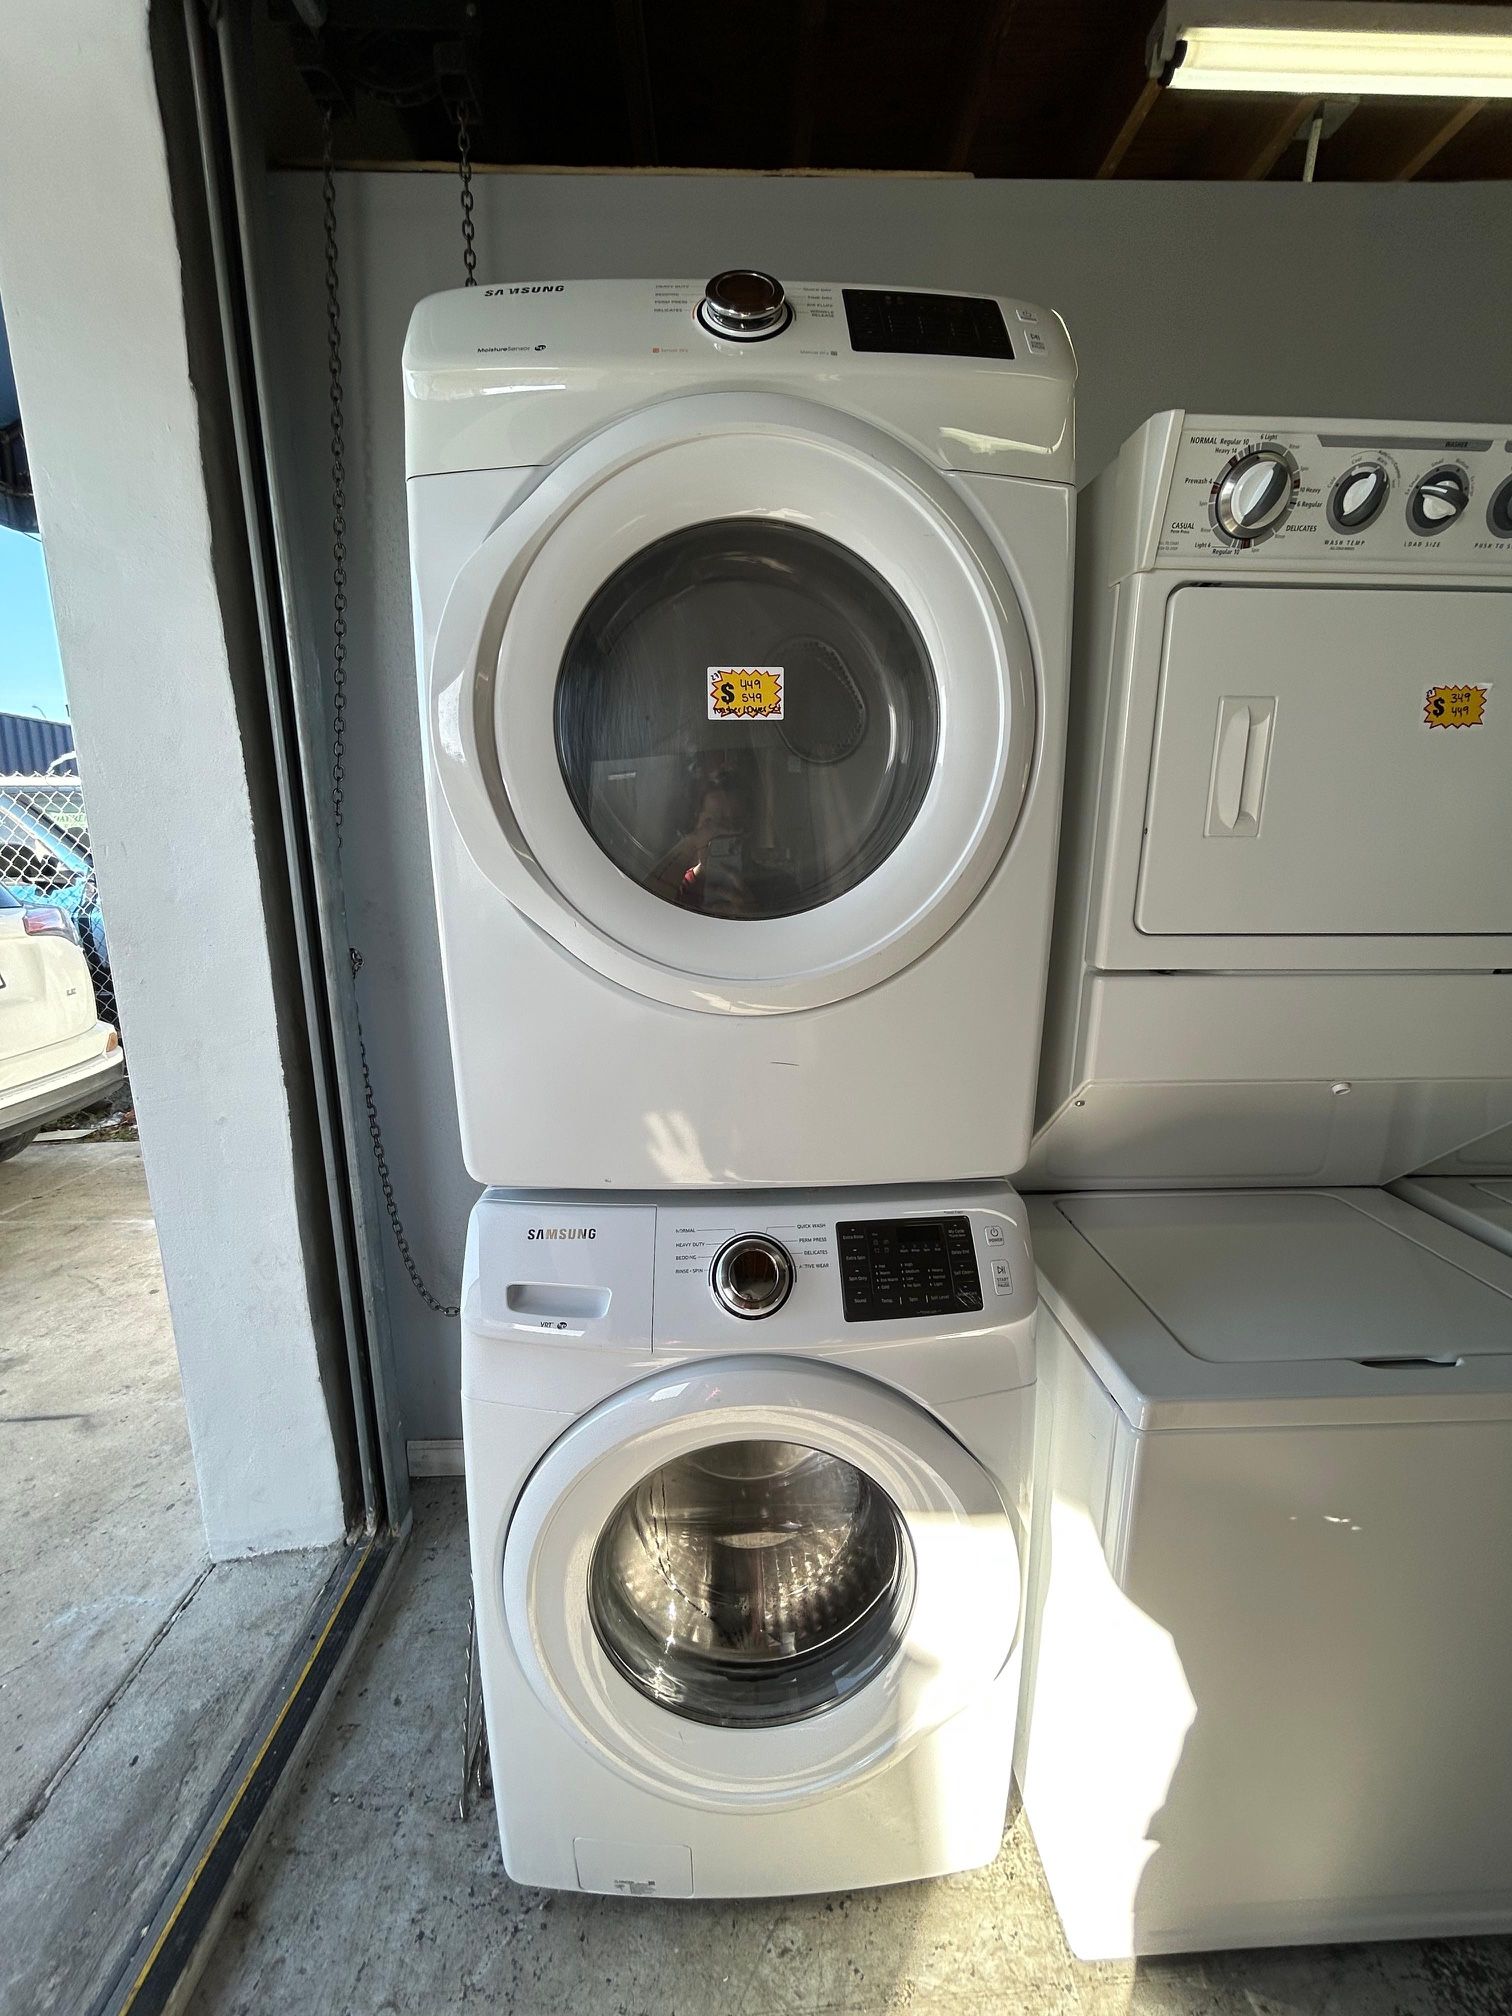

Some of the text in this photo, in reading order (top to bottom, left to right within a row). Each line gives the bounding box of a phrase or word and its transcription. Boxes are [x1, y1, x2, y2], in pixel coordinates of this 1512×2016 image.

[485, 285, 564, 296] SAMSUNG
[1190, 436, 1218, 444] NORMAL
[1220, 438, 1241, 446] Regular
[1302, 500, 1322, 509] Regular
[720, 679, 761, 704] $ 449
[742, 692, 762, 703] 549
[1432, 697, 1445, 718] $
[1451, 692, 1471, 704] 349
[1452, 706, 1469, 718] 449
[527, 1228, 596, 1240] SAMSUNG
